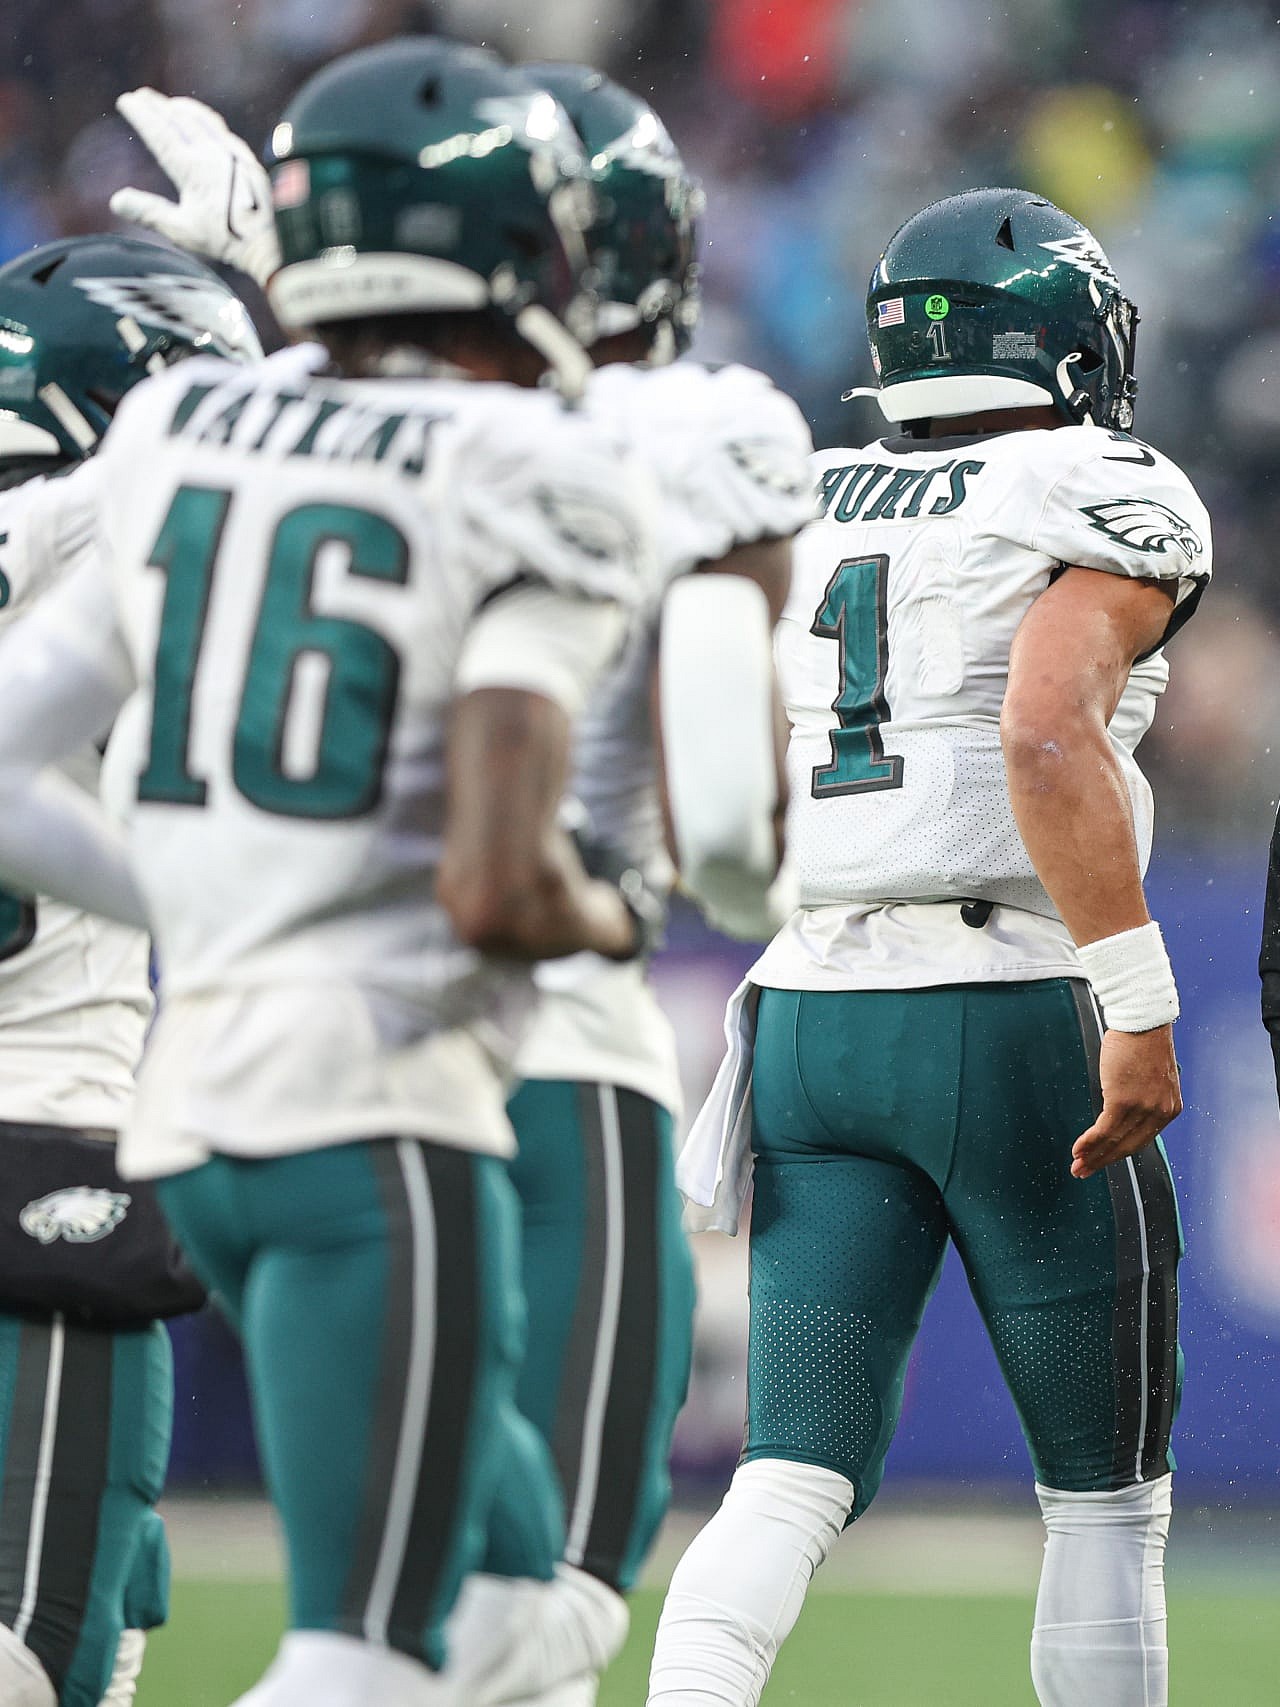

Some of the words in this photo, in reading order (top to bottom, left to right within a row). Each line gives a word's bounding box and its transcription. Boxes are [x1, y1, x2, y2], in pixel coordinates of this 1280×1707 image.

[926, 321, 951, 361] 1
[815, 459, 986, 522] HURTS
[136, 484, 410, 820] 16
[810, 553, 904, 800] 1
